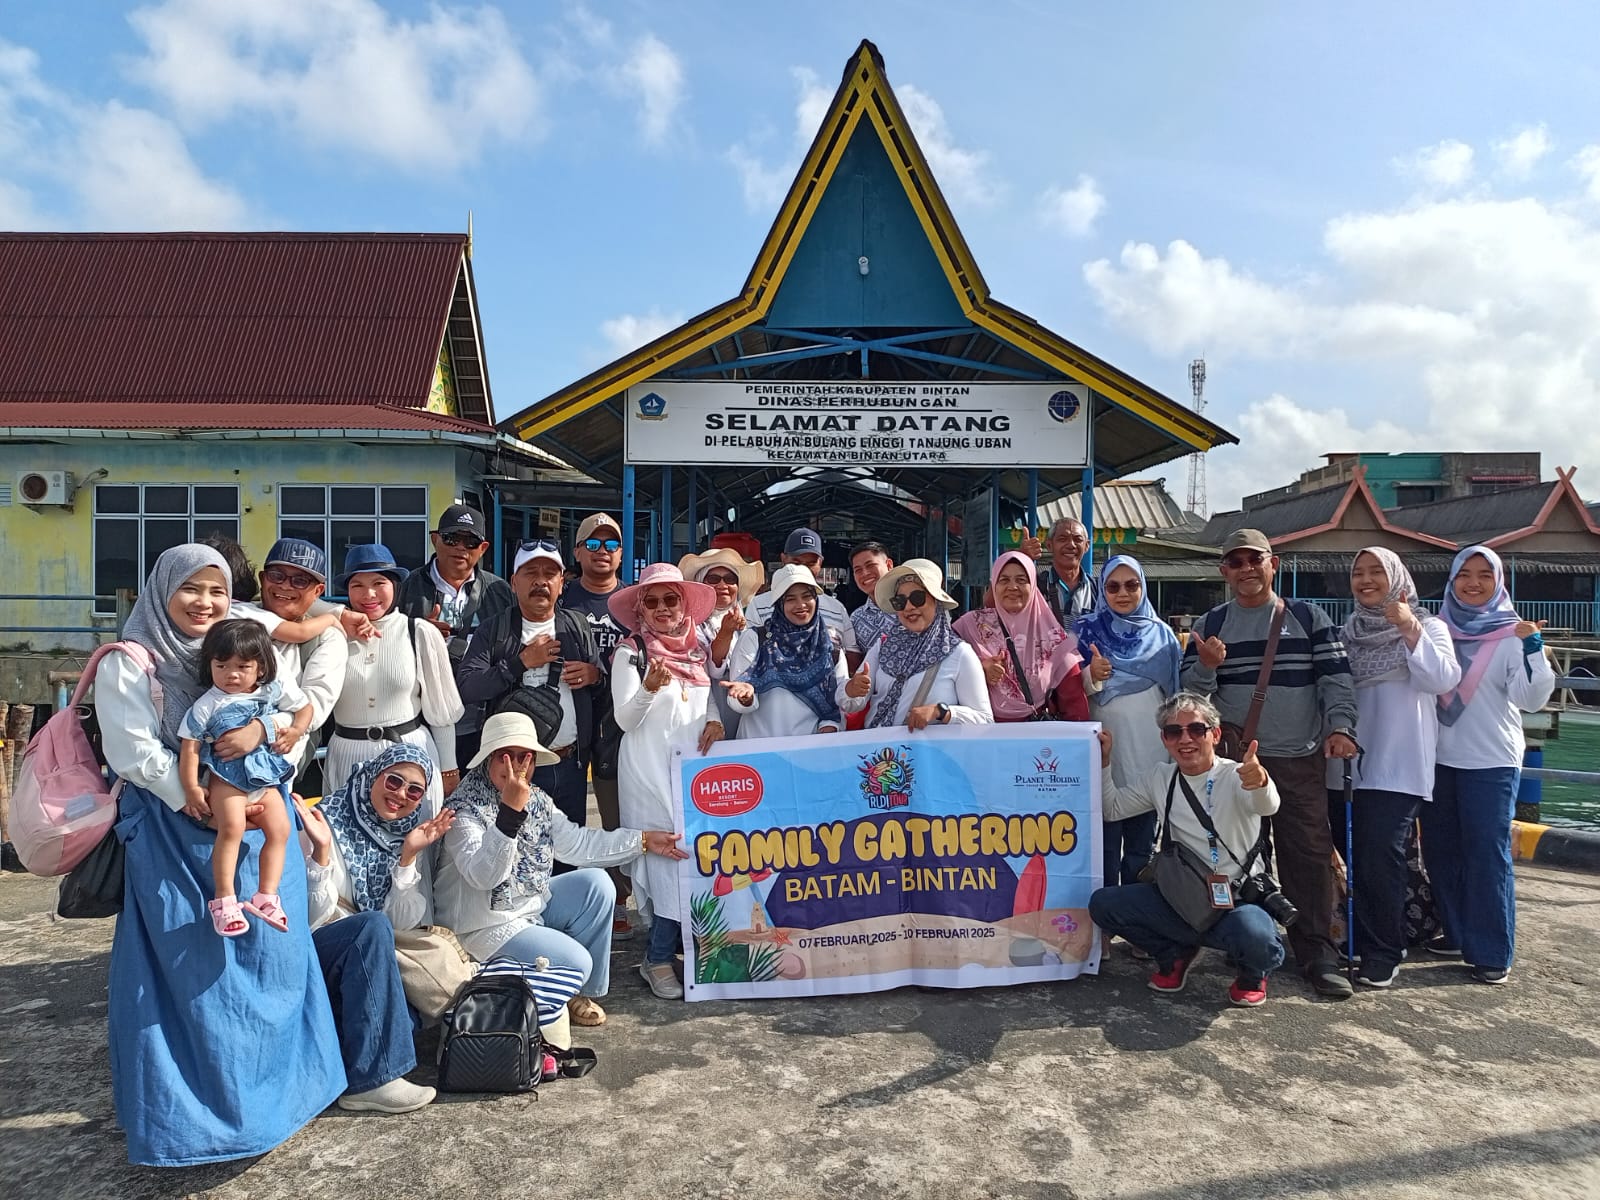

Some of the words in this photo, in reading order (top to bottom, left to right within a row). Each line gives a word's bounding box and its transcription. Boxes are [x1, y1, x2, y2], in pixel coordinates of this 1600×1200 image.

[745, 385, 831, 394] PEMERINTAH
[835, 386, 916, 395] KABUPATEN
[922, 387, 970, 395] BINTAN
[758, 396, 813, 406] DINAS
[817, 397, 957, 407] PERHUBUNGAN
[705, 413, 862, 431] SELAMAT
[877, 415, 1010, 431] DATANG
[704, 435, 717, 447] DI
[721, 435, 800, 448] PELABUHAN
[804, 436, 857, 448] BULANG
[860, 437, 904, 448] LINGGI
[909, 437, 970, 448] TANJUNG
[975, 437, 1012, 448] UBAN
[767, 450, 847, 460] KECAMATAN
[851, 451, 898, 460] BINTAN
[903, 452, 946, 460] UTARA
[700, 778, 755, 795] HARRIS
[1015, 774, 1044, 784] PLANET
[1048, 774, 1081, 784] HOLIDAY
[695, 821, 847, 876] FAMILY
[852, 812, 1076, 862] GATHERING
[785, 871, 881, 903] BATAM
[901, 866, 997, 892] BINTAN
[799, 938, 813, 949] 07
[814, 932, 870, 948] FEBRUARI
[871, 930, 897, 945] 2025
[903, 928, 914, 940] 10
[915, 928, 969, 939] FEBRUARI
[970, 927, 995, 938] 2025
